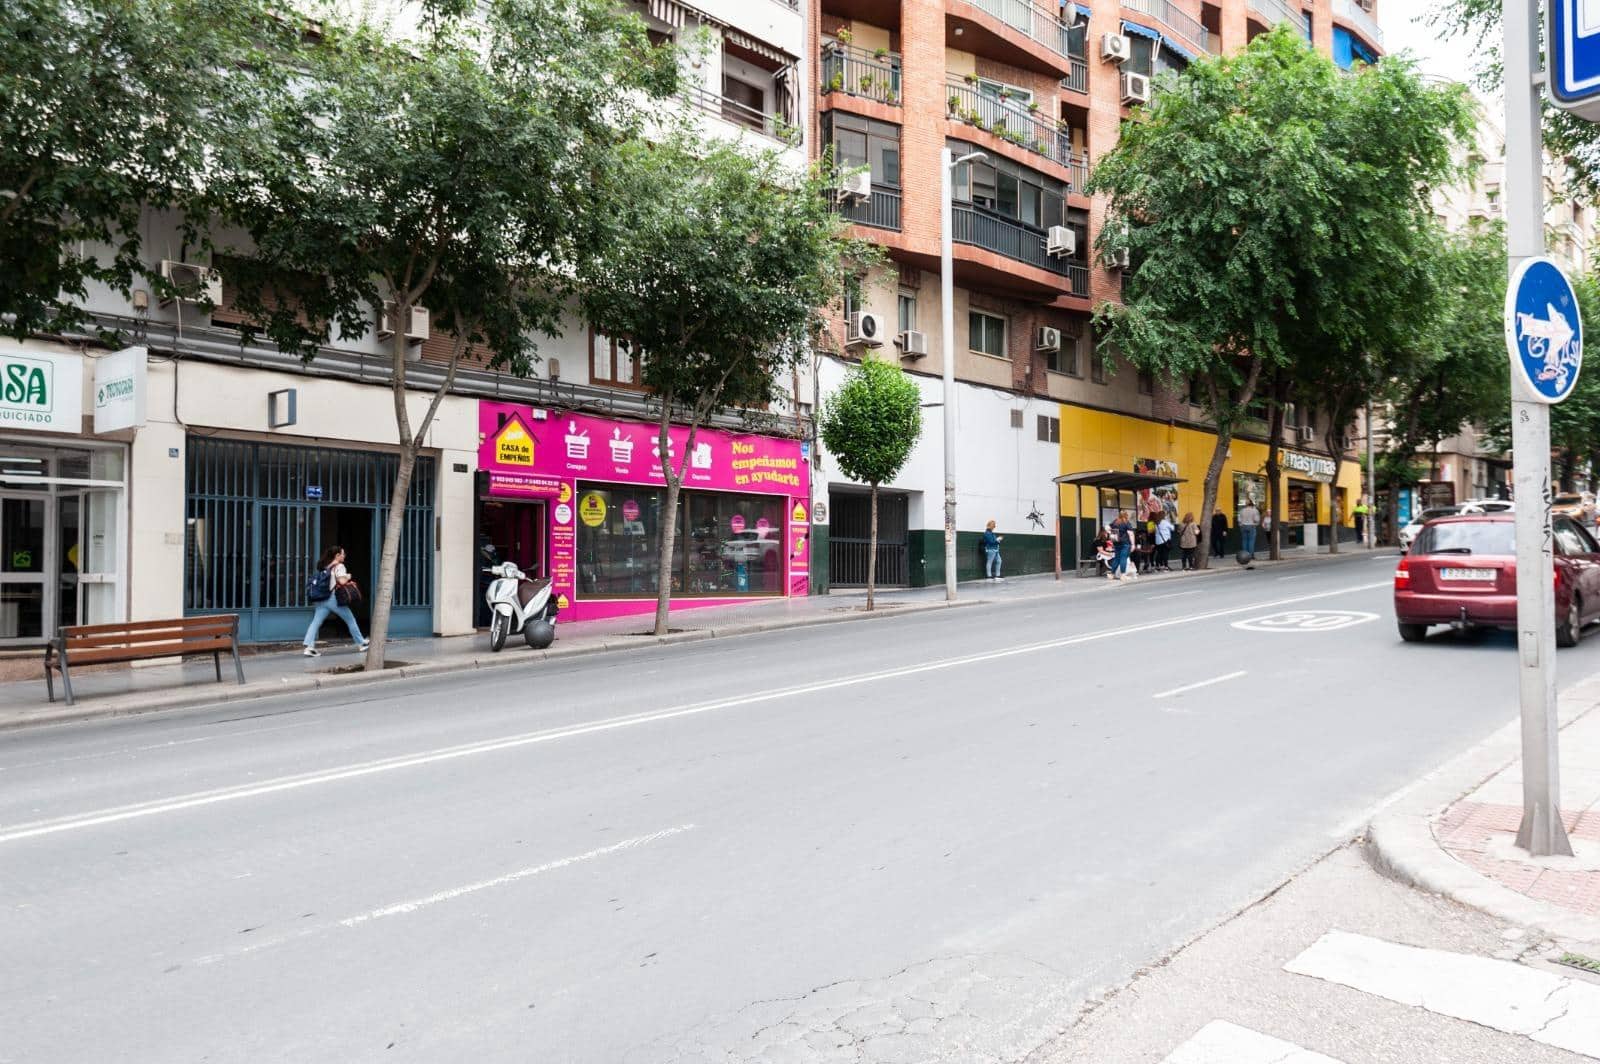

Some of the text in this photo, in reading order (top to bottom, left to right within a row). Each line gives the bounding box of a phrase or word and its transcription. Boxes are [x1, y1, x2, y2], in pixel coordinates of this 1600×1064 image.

[0, 364, 46, 405] SA
[0, 411, 52, 423] UICIADO
[501, 444, 519, 452] CASA
[732, 441, 754, 454] Nos
[732, 455, 797, 470] empeñamos
[735, 470, 799, 486] en ayudarte
